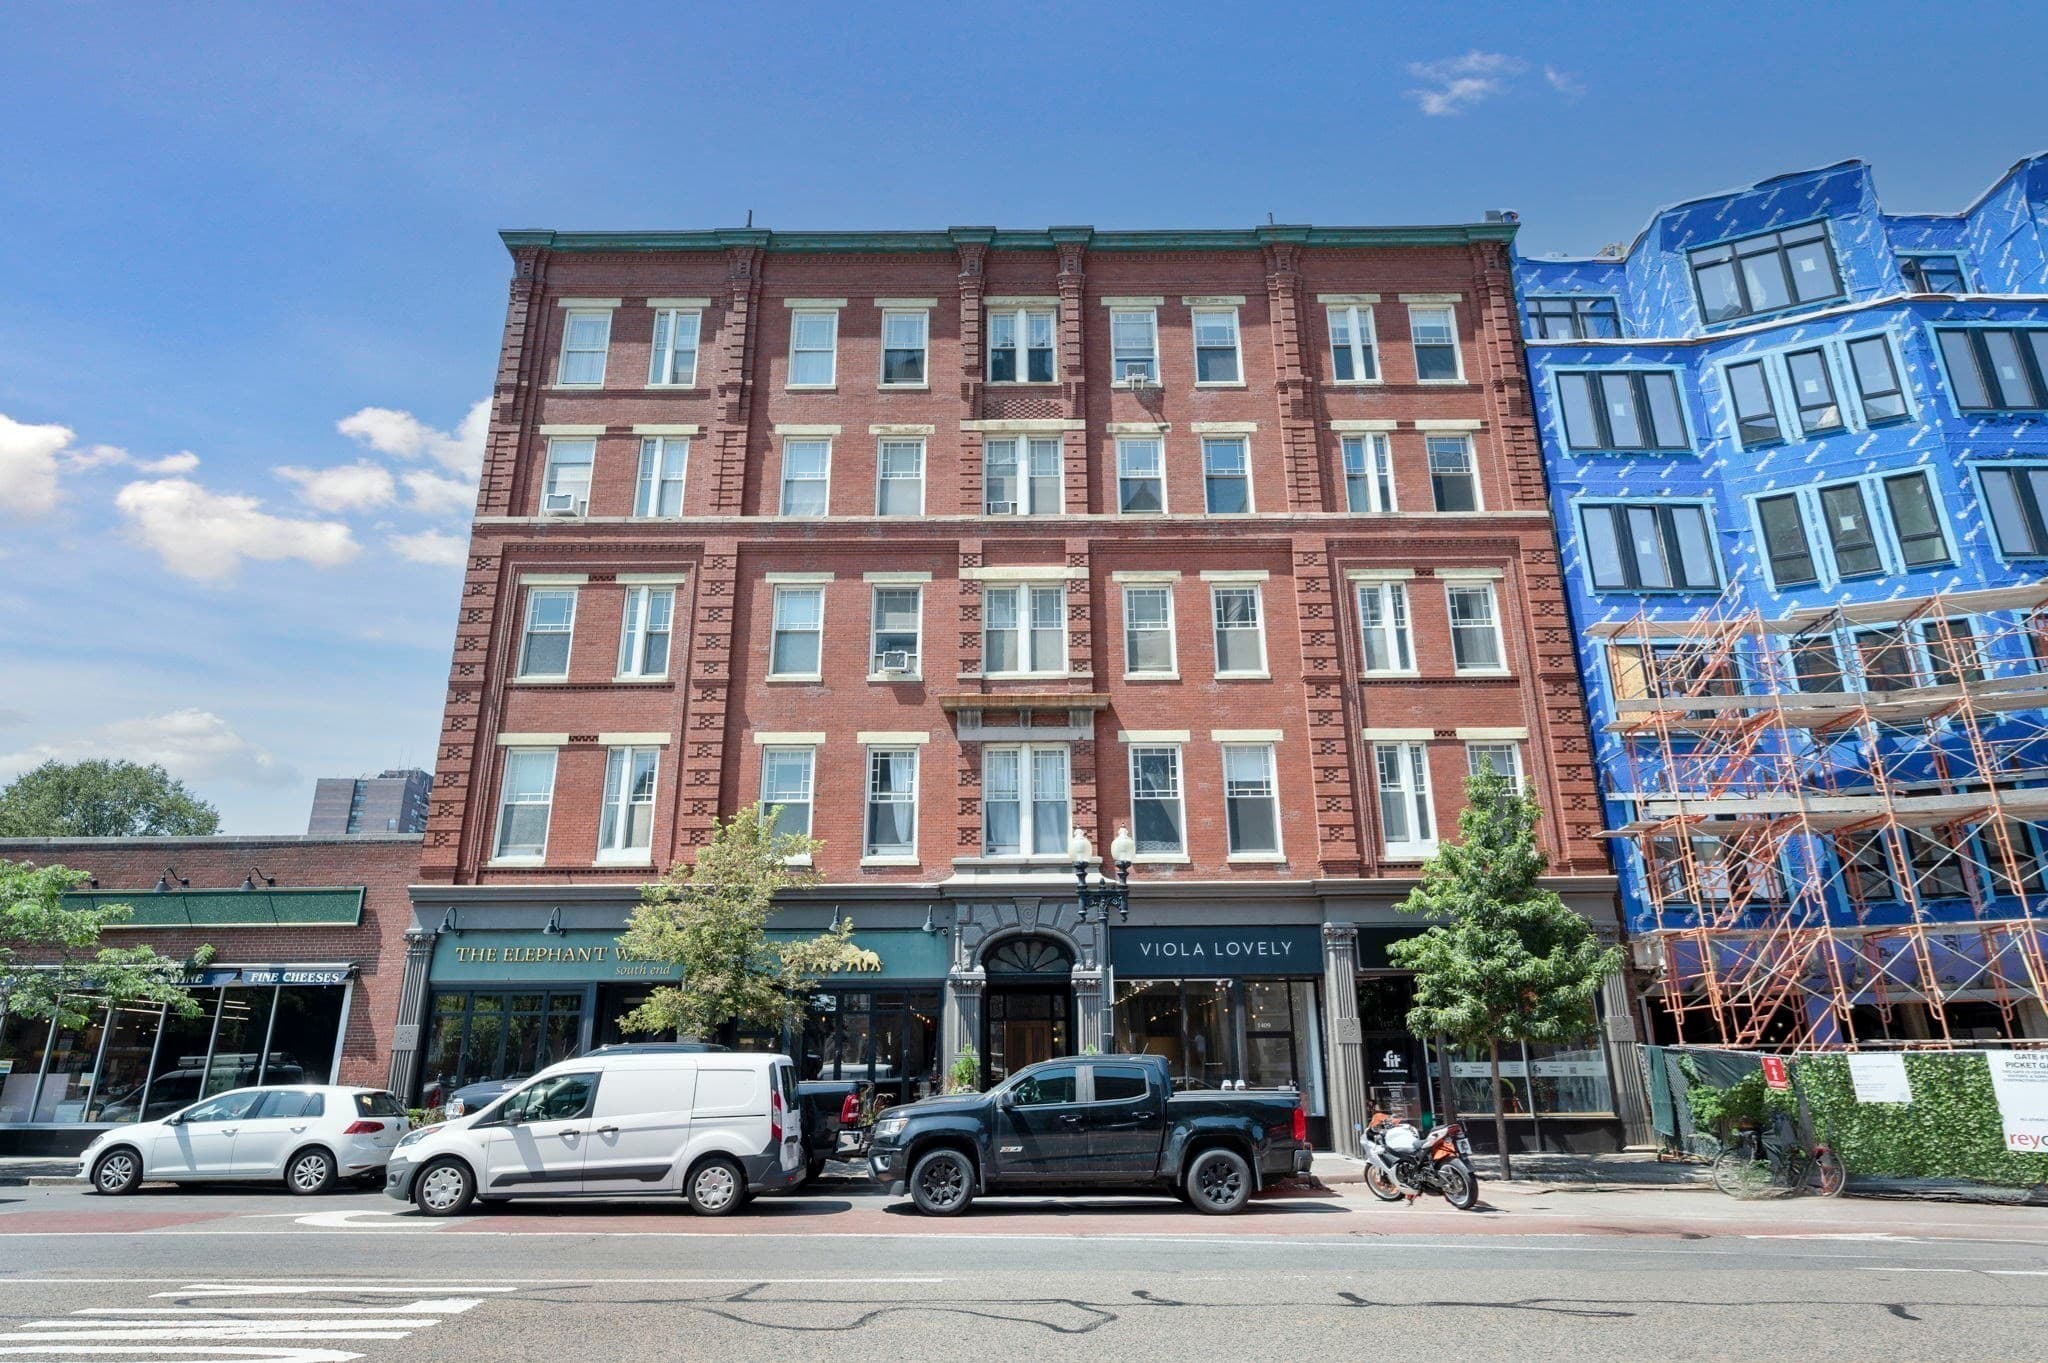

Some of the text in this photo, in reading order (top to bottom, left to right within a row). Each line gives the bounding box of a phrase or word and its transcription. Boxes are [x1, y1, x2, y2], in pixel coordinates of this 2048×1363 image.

[456, 947, 497, 962] THE
[503, 947, 608, 962] ELEPHANT
[1140, 941, 1292, 956] VIOLA LOVELY
[616, 961, 671, 976] south end
[250, 971, 341, 983] FINE CHEESES
[1383, 1050, 1401, 1067] fit
